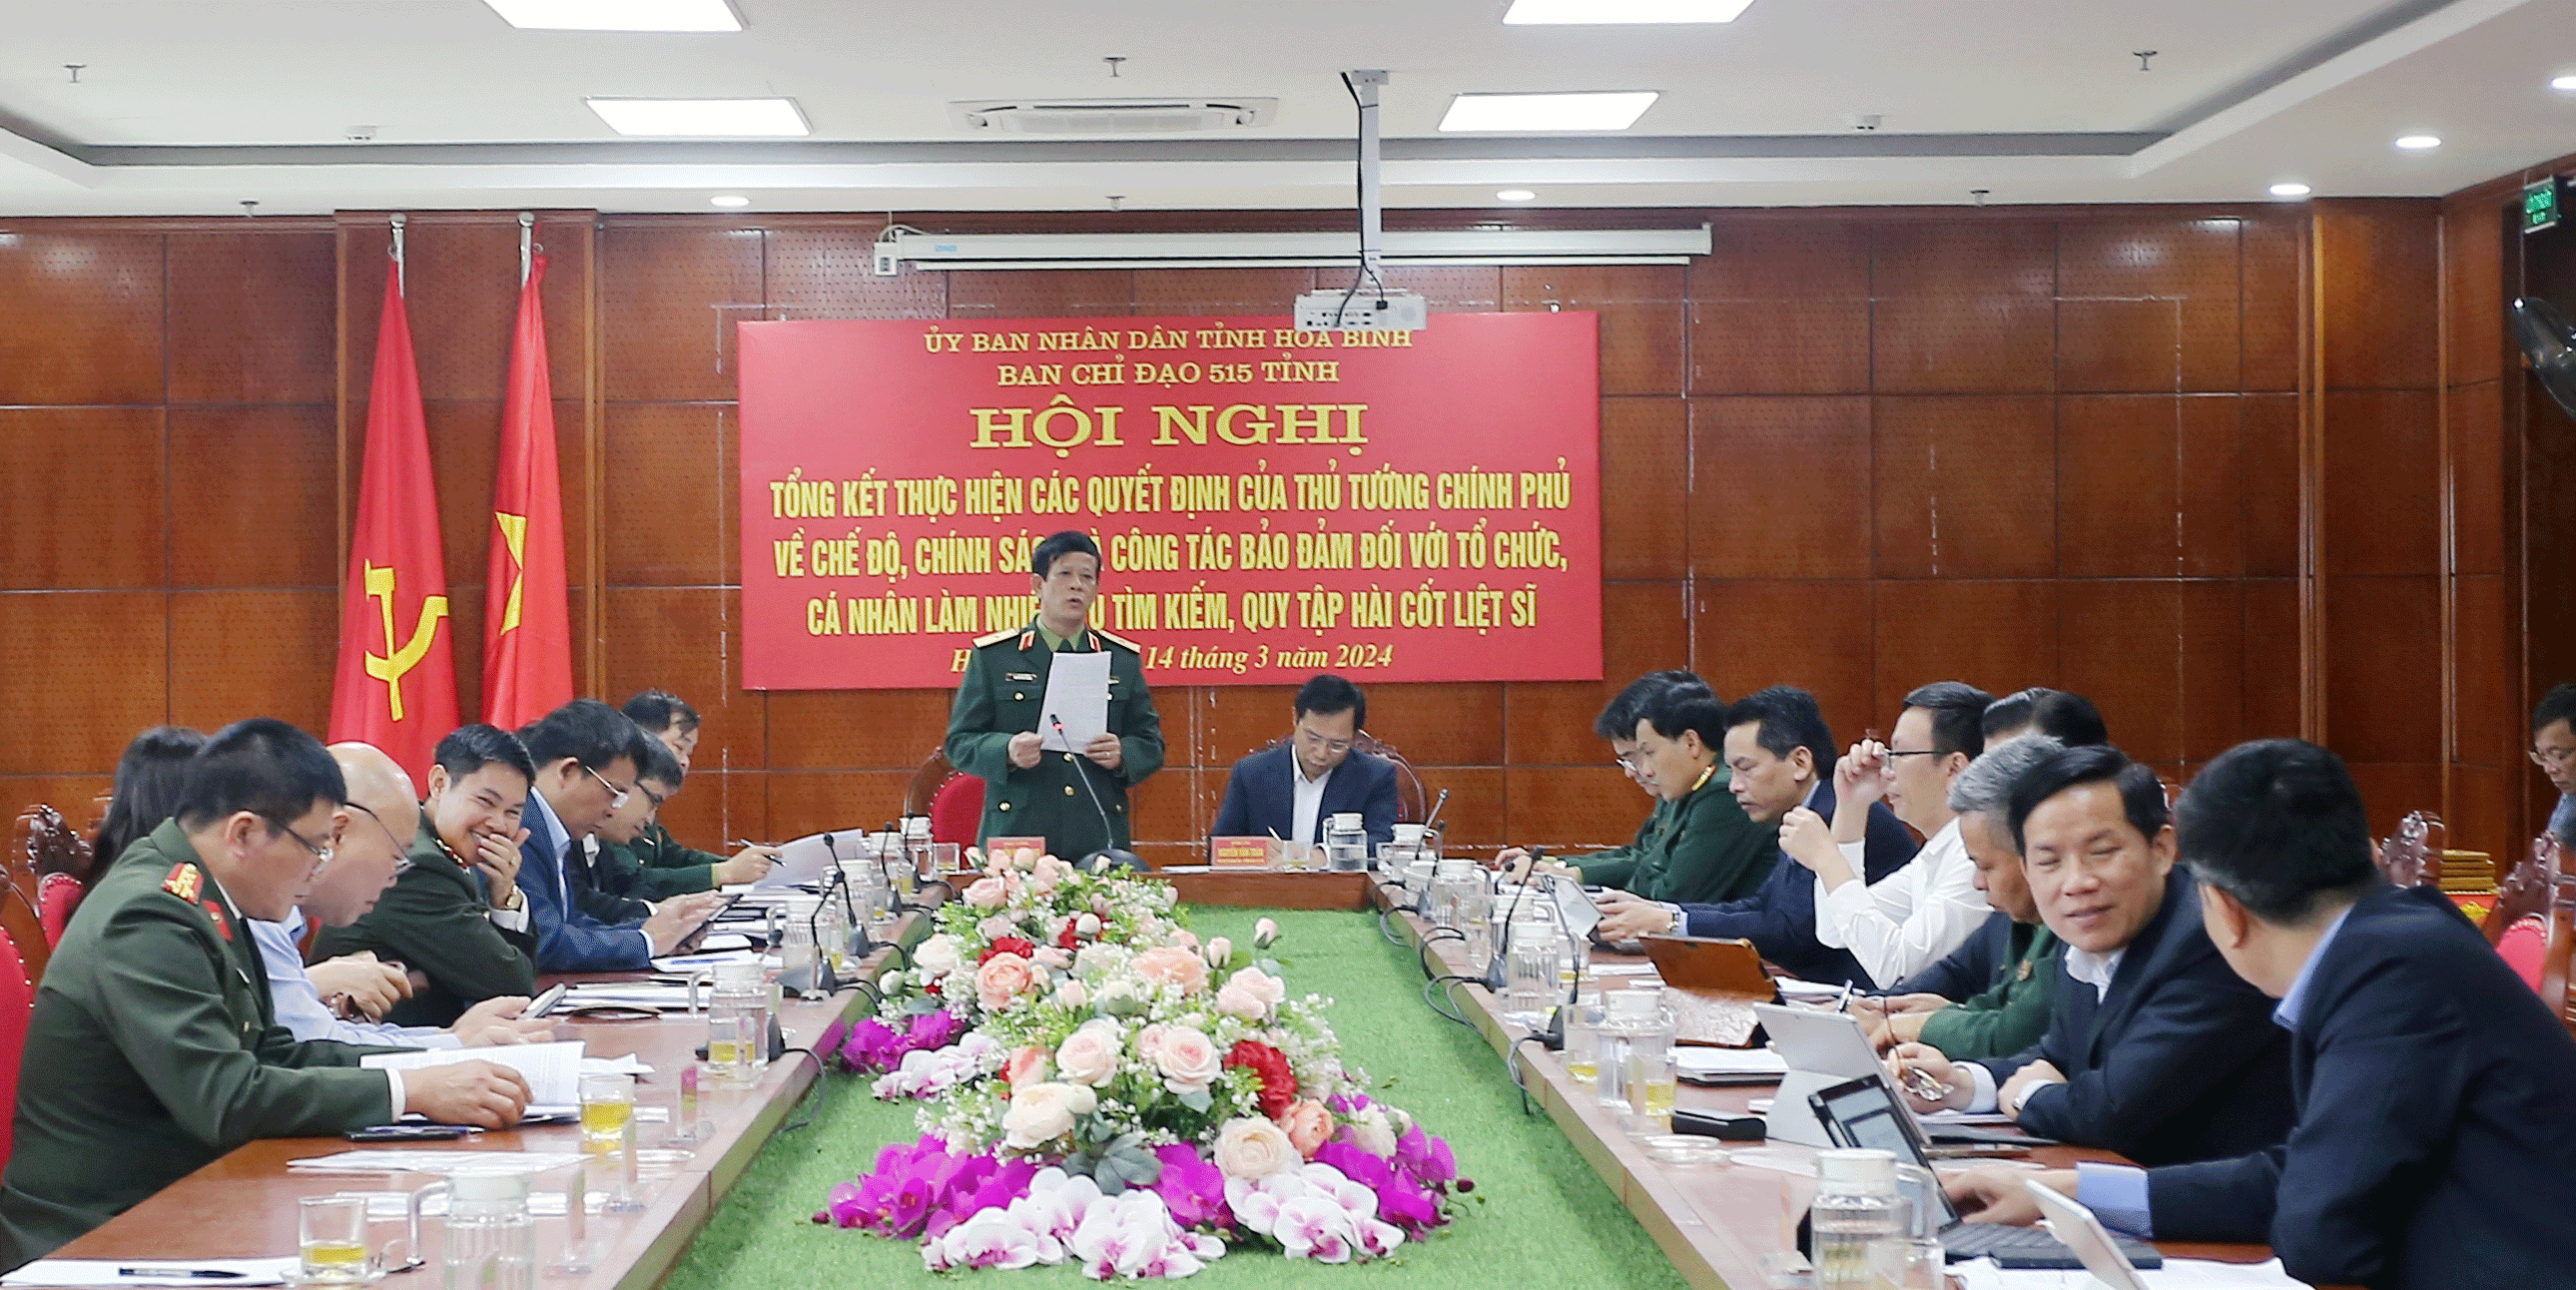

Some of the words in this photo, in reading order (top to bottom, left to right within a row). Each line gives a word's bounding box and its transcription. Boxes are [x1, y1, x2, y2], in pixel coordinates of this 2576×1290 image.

[924, 324, 964, 353] ỦY
[971, 332, 1029, 352] BAN
[1038, 325, 1119, 351] NHÂN
[1128, 324, 1188, 349] DÂN
[1196, 322, 1266, 348] TỈNH
[997, 364, 1062, 386] BAN
[1070, 354, 1124, 385] CHỈ
[1134, 361, 1201, 388] ĐẠO
[1209, 363, 1253, 383] 515
[1260, 351, 1340, 382] TỈNH
[969, 393, 1124, 458] HỘI
[1151, 403, 1369, 456] NGHỊ
[769, 466, 836, 518] TỔNG
[842, 466, 889, 517] KẾT
[893, 474, 958, 523] THỰC
[965, 470, 1023, 523] HIỆN
[1029, 469, 1080, 514] CÁC
[1086, 462, 1164, 517] QUYẾT
[1169, 474, 1230, 520] ĐỊNH
[1237, 458, 1288, 511] CỦA
[1293, 458, 1341, 510] THỦ
[1347, 462, 1430, 510] TƯỚNG
[1436, 464, 1514, 510] CHÍNH
[1520, 456, 1571, 509] PHỦ
[773, 526, 805, 577] VỀ
[811, 526, 862, 577] CHẾ
[866, 531, 908, 583] ĐỘ,
[915, 529, 991, 575] CHÍNH
[1110, 526, 1179, 572] CÔNG
[1185, 526, 1233, 570] TÁC
[1239, 517, 1290, 570] BẢO
[1296, 517, 1354, 569] ĐẢM
[1359, 519, 1402, 569] ĐỐI
[1408, 520, 1450, 569] VỚI
[1455, 517, 1488, 568] TỔ
[1493, 520, 1568, 572] CHỨC,
[807, 591, 842, 636] CÁ
[848, 589, 918, 635] NHÂN
[925, 588, 978, 633] LÀM
[1111, 586, 1157, 630] TÌM
[1164, 579, 1235, 633] KIẾM,
[1242, 592, 1291, 633] QUY
[1296, 584, 1344, 636] TẬP
[1351, 583, 1393, 628] HÀI
[1400, 577, 1448, 628] CỐT
[1454, 583, 1505, 635] LIỆT
[1511, 583, 1538, 627] SĨ
[1146, 646, 1174, 669] 14
[1180, 645, 1249, 675] tháng
[1254, 645, 1269, 668] 3
[1277, 647, 1329, 668] năm
[1335, 644, 1393, 668] 2024
